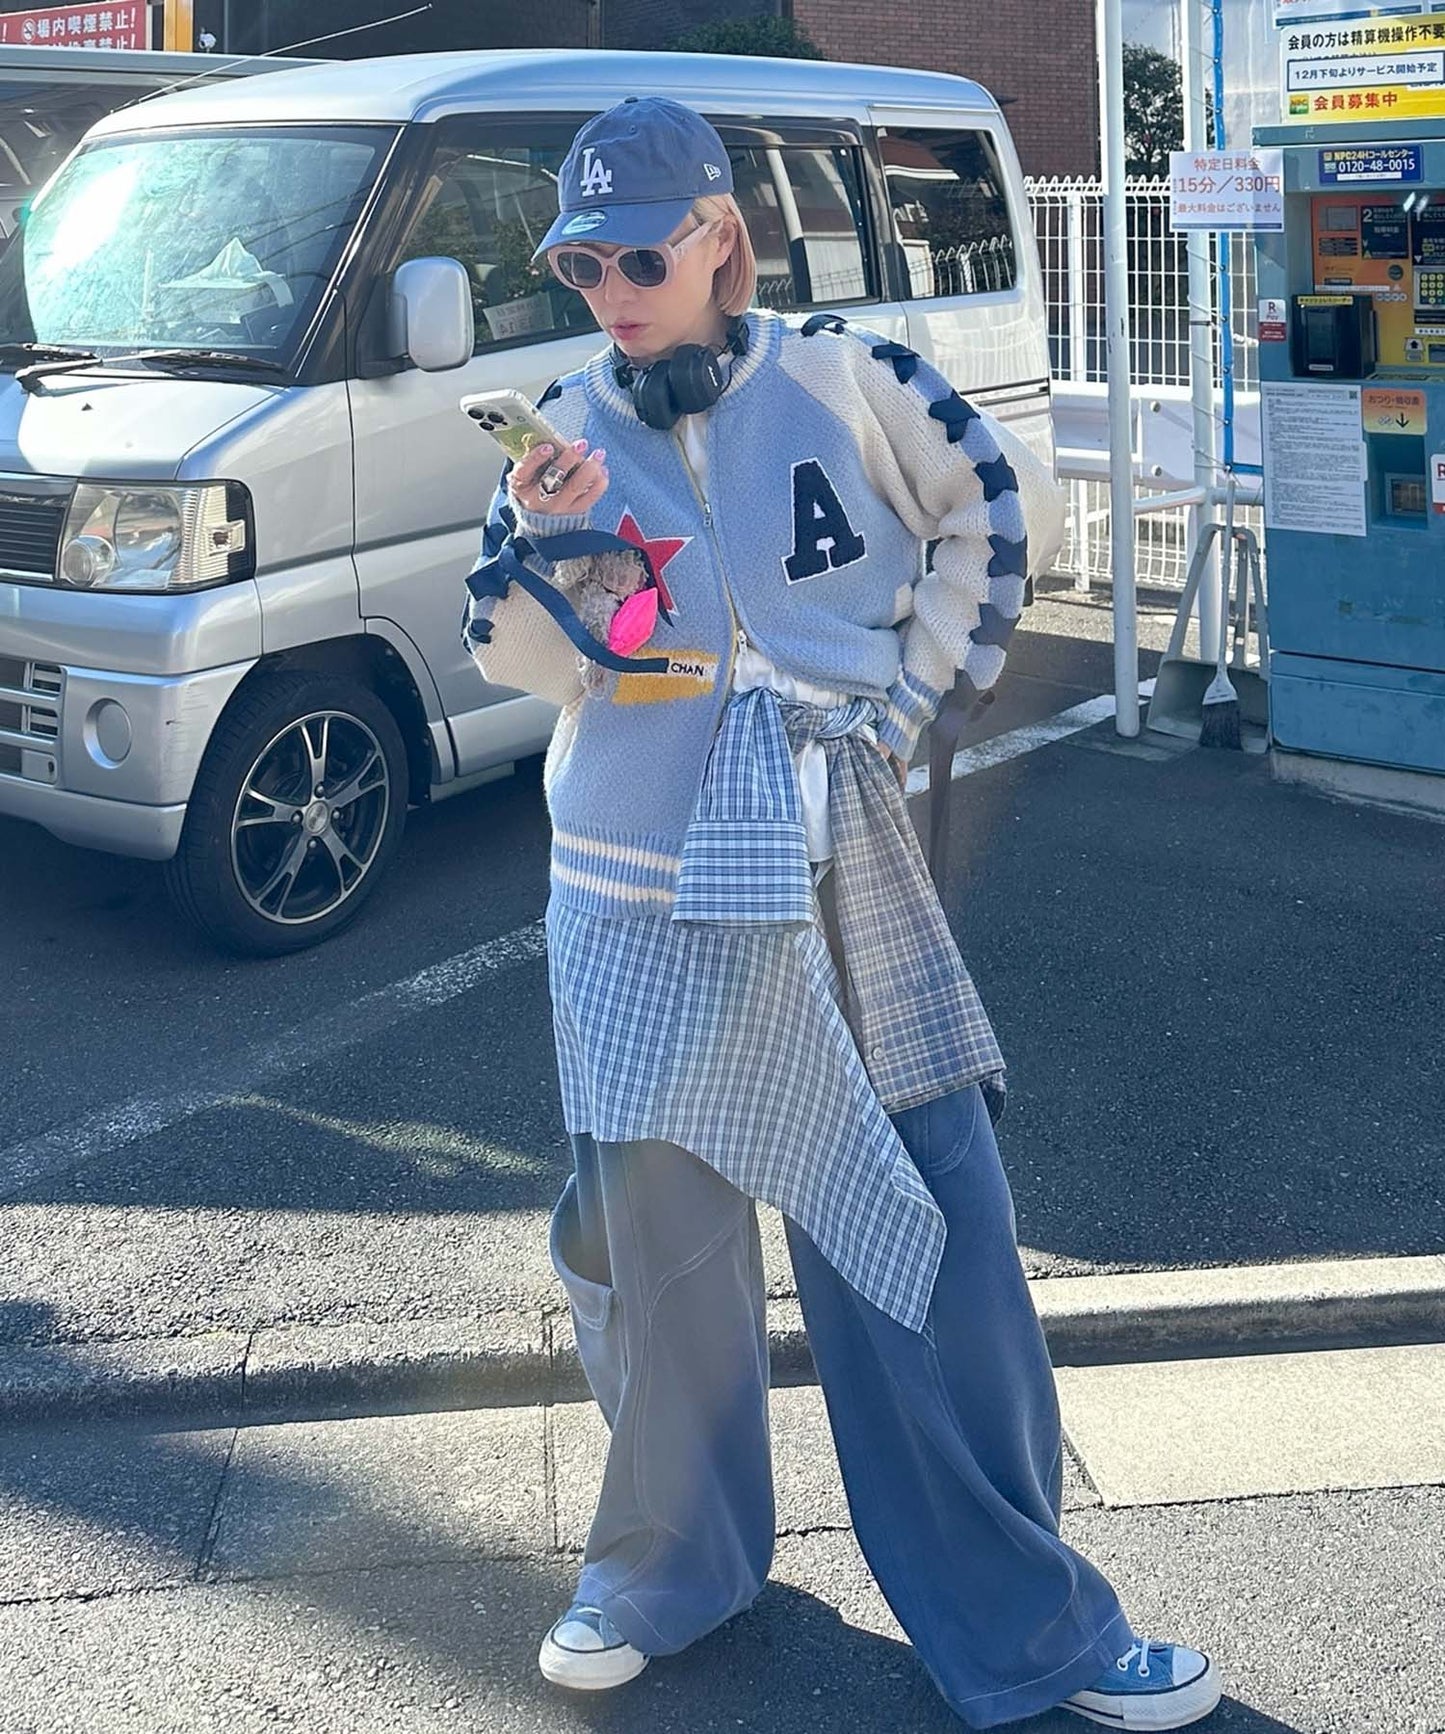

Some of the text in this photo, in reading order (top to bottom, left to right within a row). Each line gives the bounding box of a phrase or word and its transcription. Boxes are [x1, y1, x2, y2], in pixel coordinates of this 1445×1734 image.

[1314, 92, 1398, 111] 会員募集中
[580, 147, 613, 197] LA
[1194, 157, 1260, 171] 特定日料金
[1338, 159, 1415, 172] 0120-48-0015
[781, 457, 868, 585] A
[671, 662, 705, 676] CHAN
